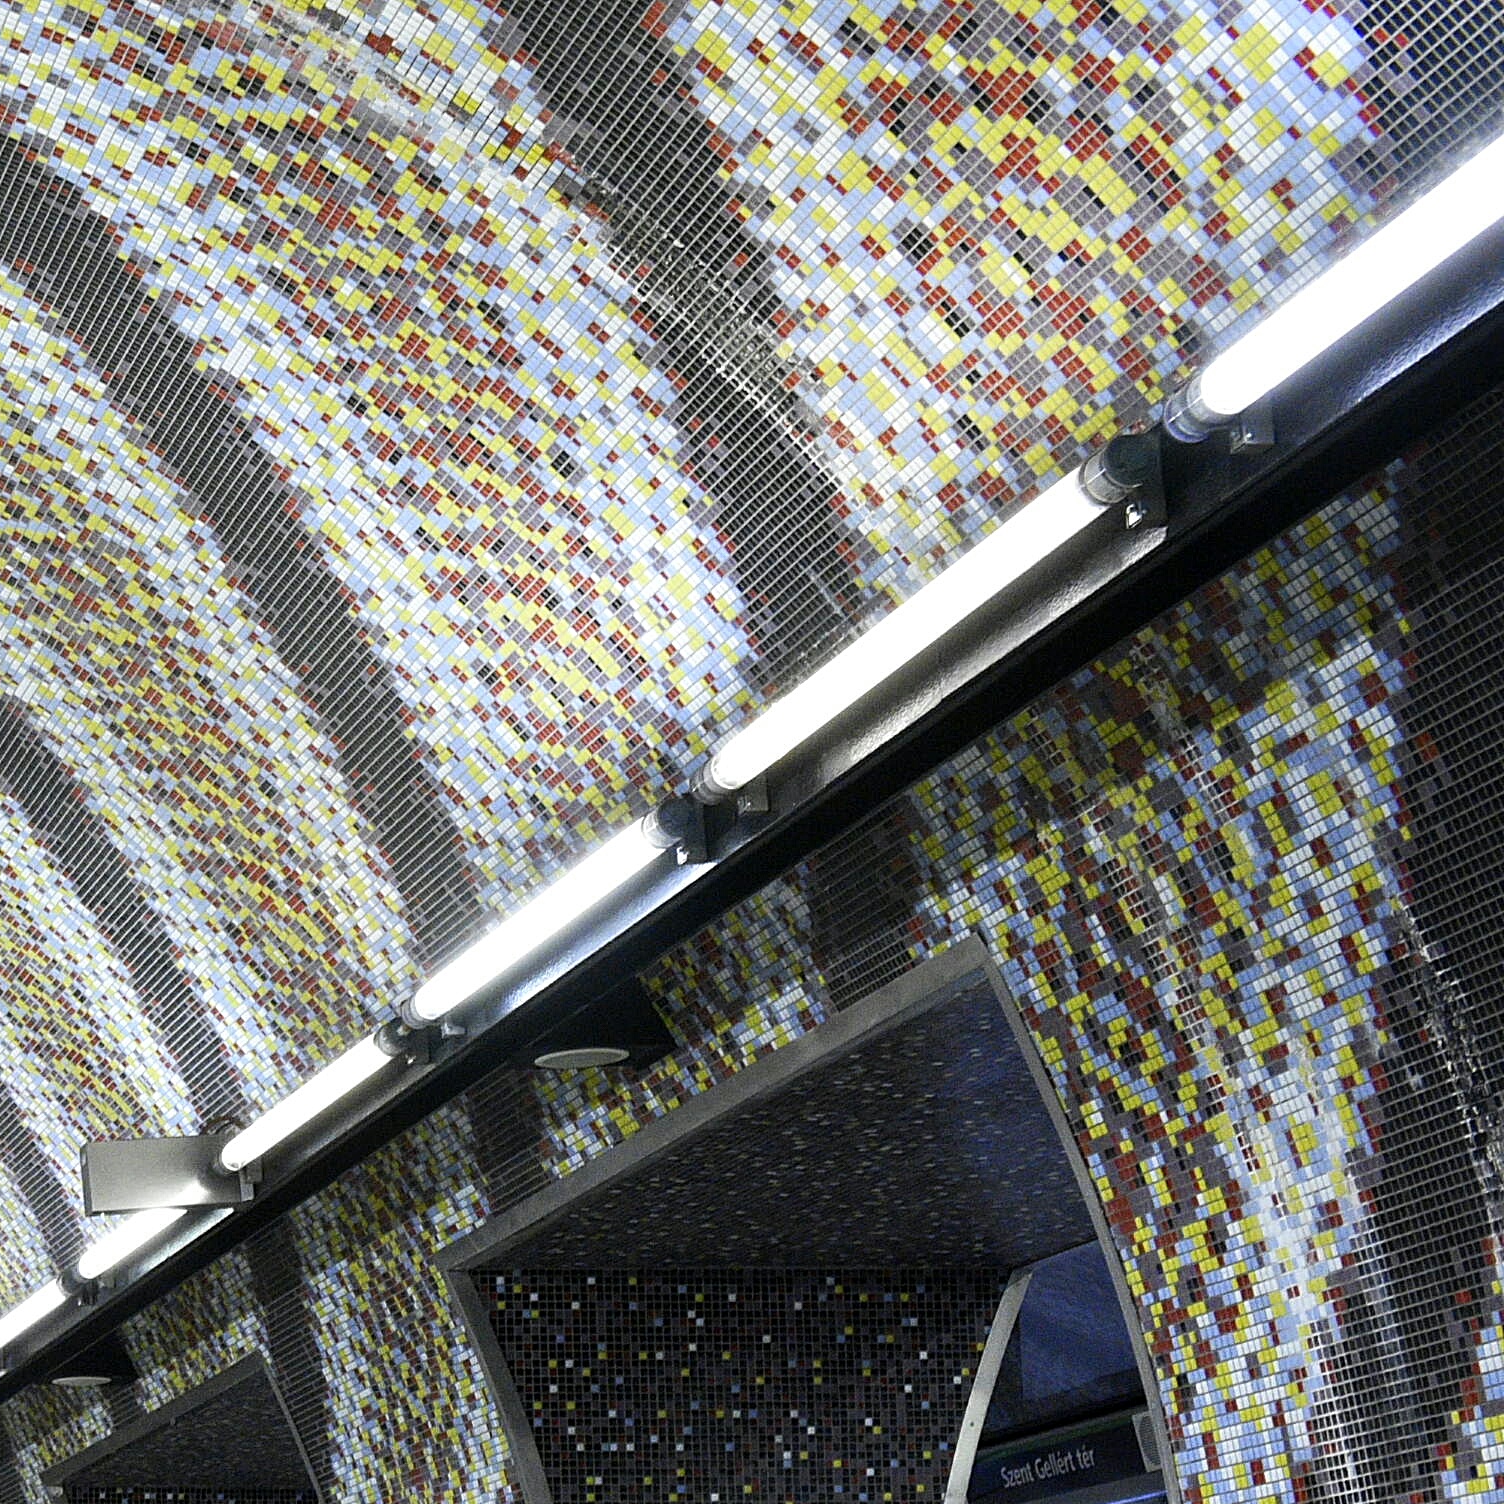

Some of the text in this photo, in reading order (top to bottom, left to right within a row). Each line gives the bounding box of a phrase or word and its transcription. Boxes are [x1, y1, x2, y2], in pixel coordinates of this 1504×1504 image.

[1000, 1444, 1096, 1489] Szent Gellért tér
